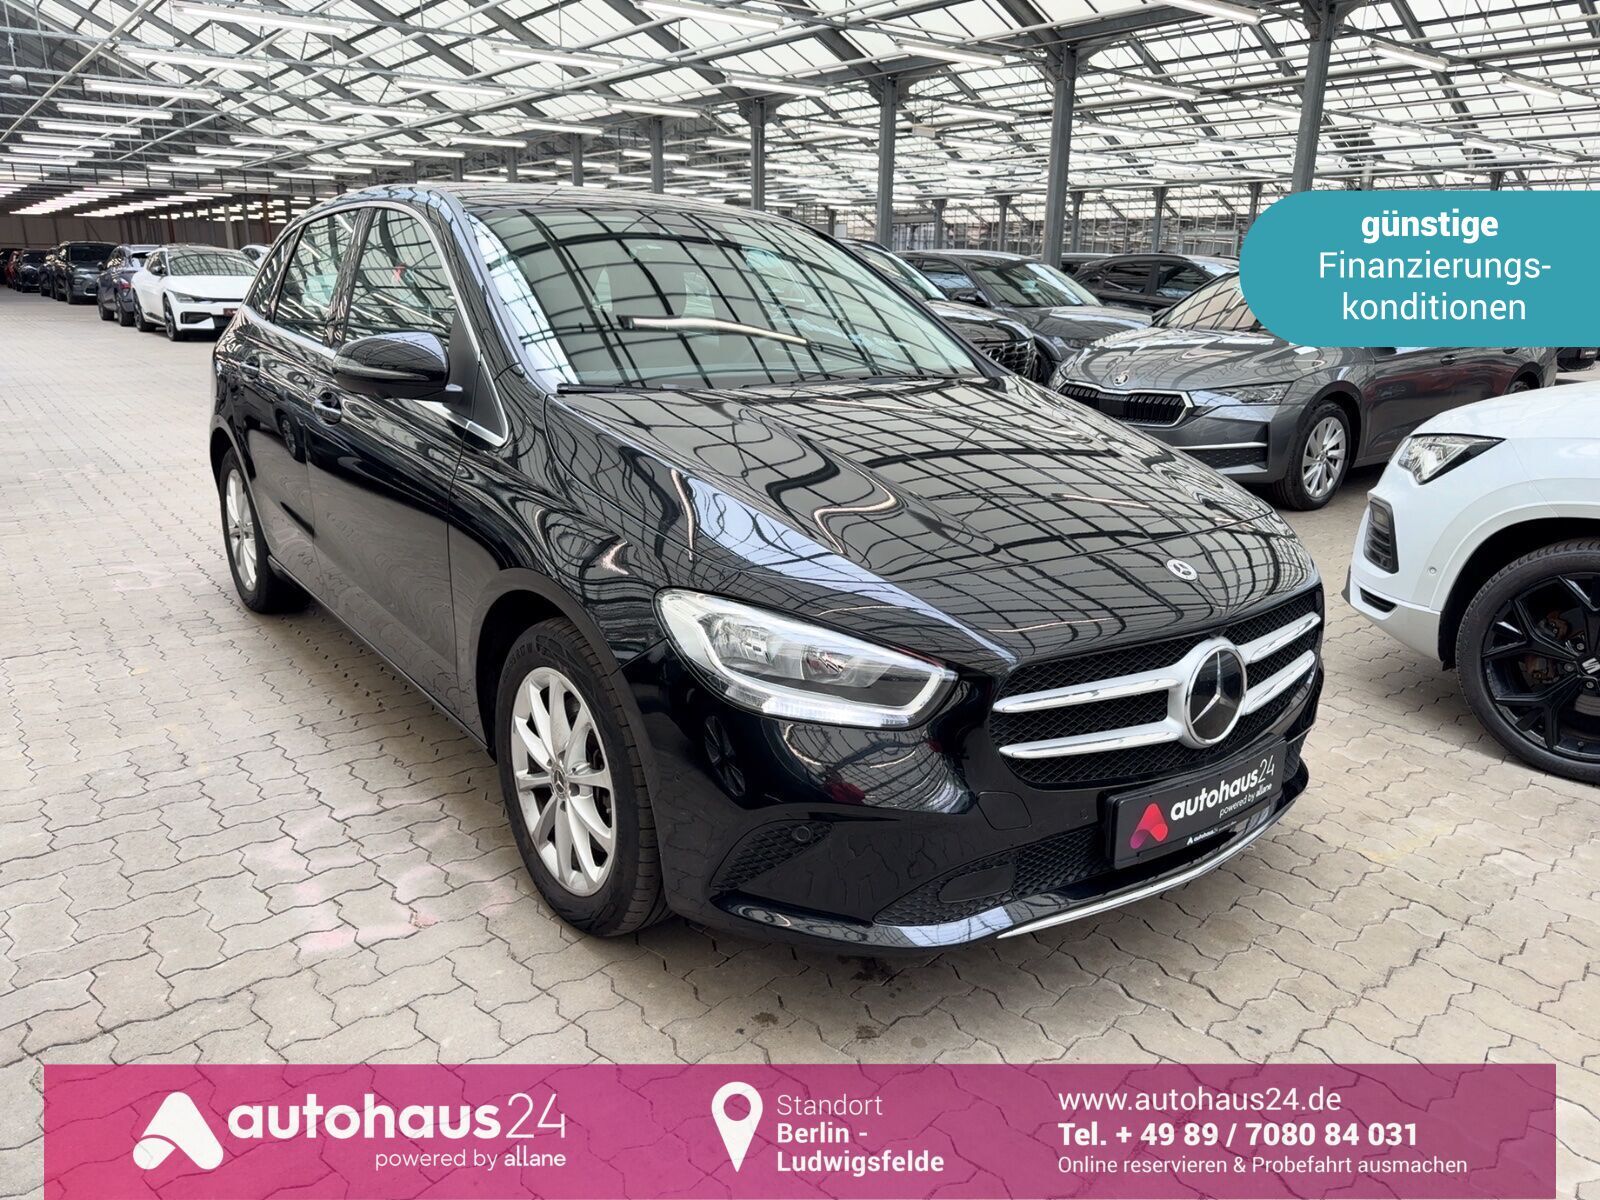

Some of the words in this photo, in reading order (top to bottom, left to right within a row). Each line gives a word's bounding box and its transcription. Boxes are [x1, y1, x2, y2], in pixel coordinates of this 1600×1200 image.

[1170, 755, 1275, 821] autohaus24
[1219, 795, 1247, 819] powered
[1247, 792, 1256, 803] by
